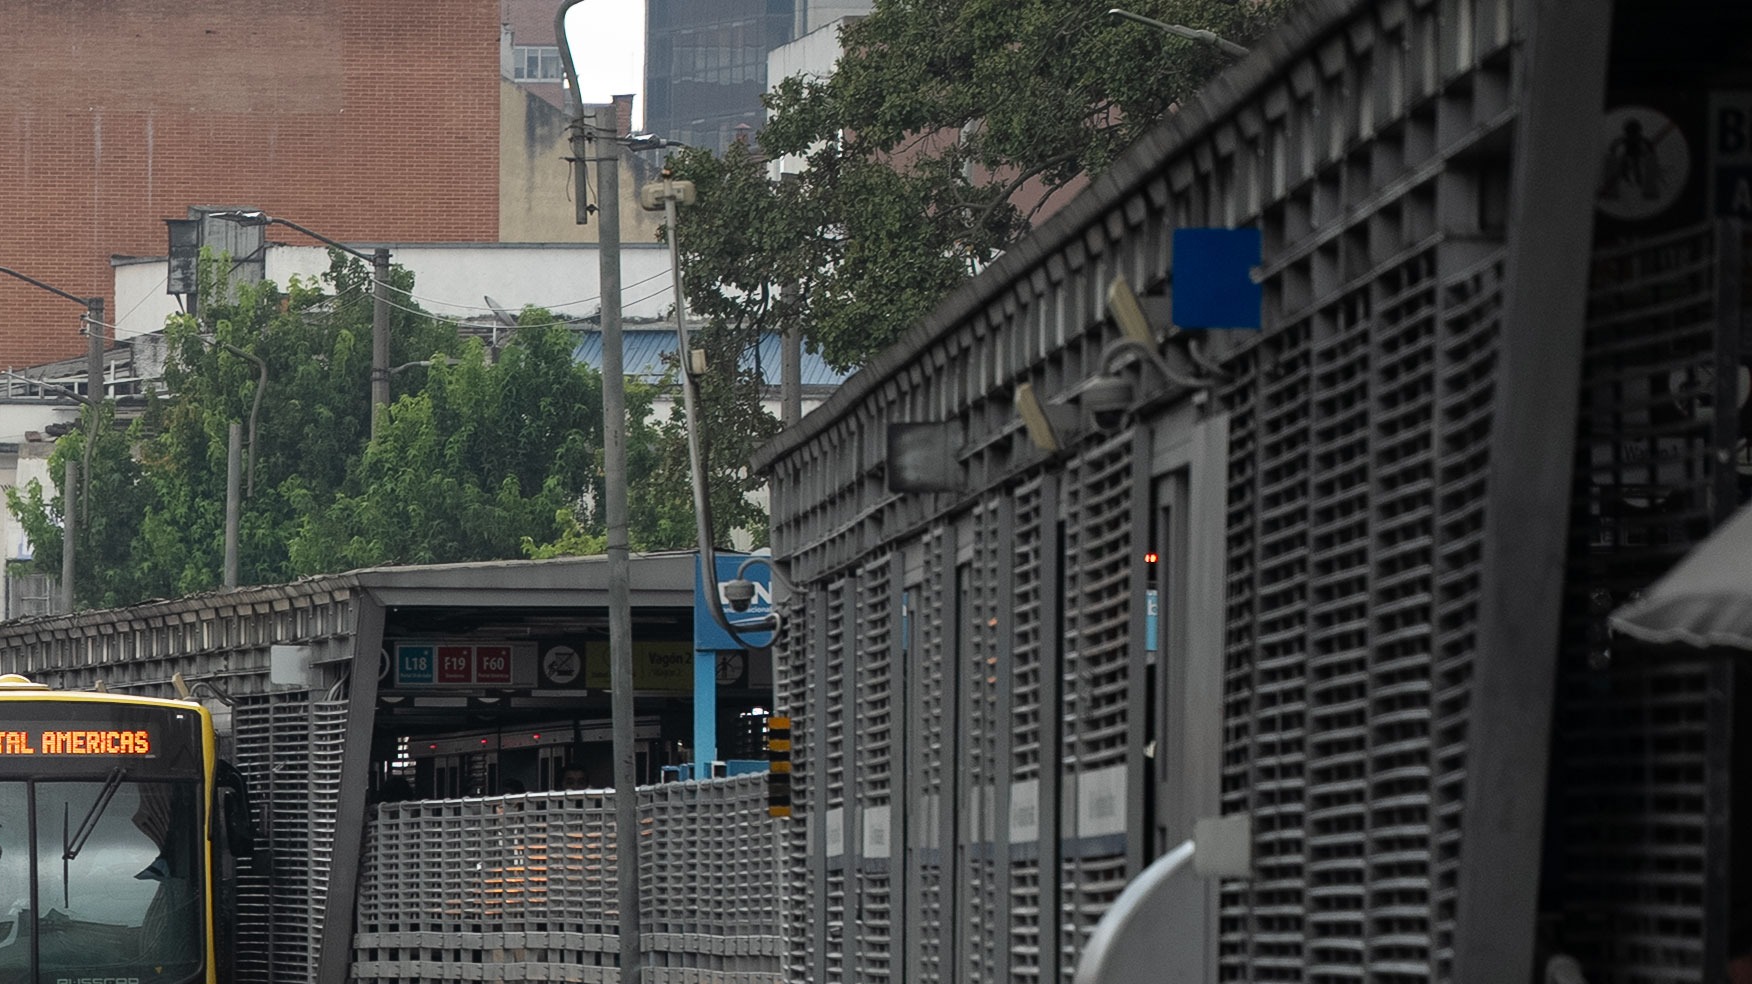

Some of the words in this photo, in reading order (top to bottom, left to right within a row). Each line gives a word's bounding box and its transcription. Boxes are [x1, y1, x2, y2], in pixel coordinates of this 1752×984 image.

[404, 656, 428, 671] L18
[443, 656, 466, 671] F19
[482, 656, 505, 671] F60
[648, 651, 683, 667] Vagón
[684, 651, 692, 665] 2
[41, 731, 151, 755] AMERICAS
